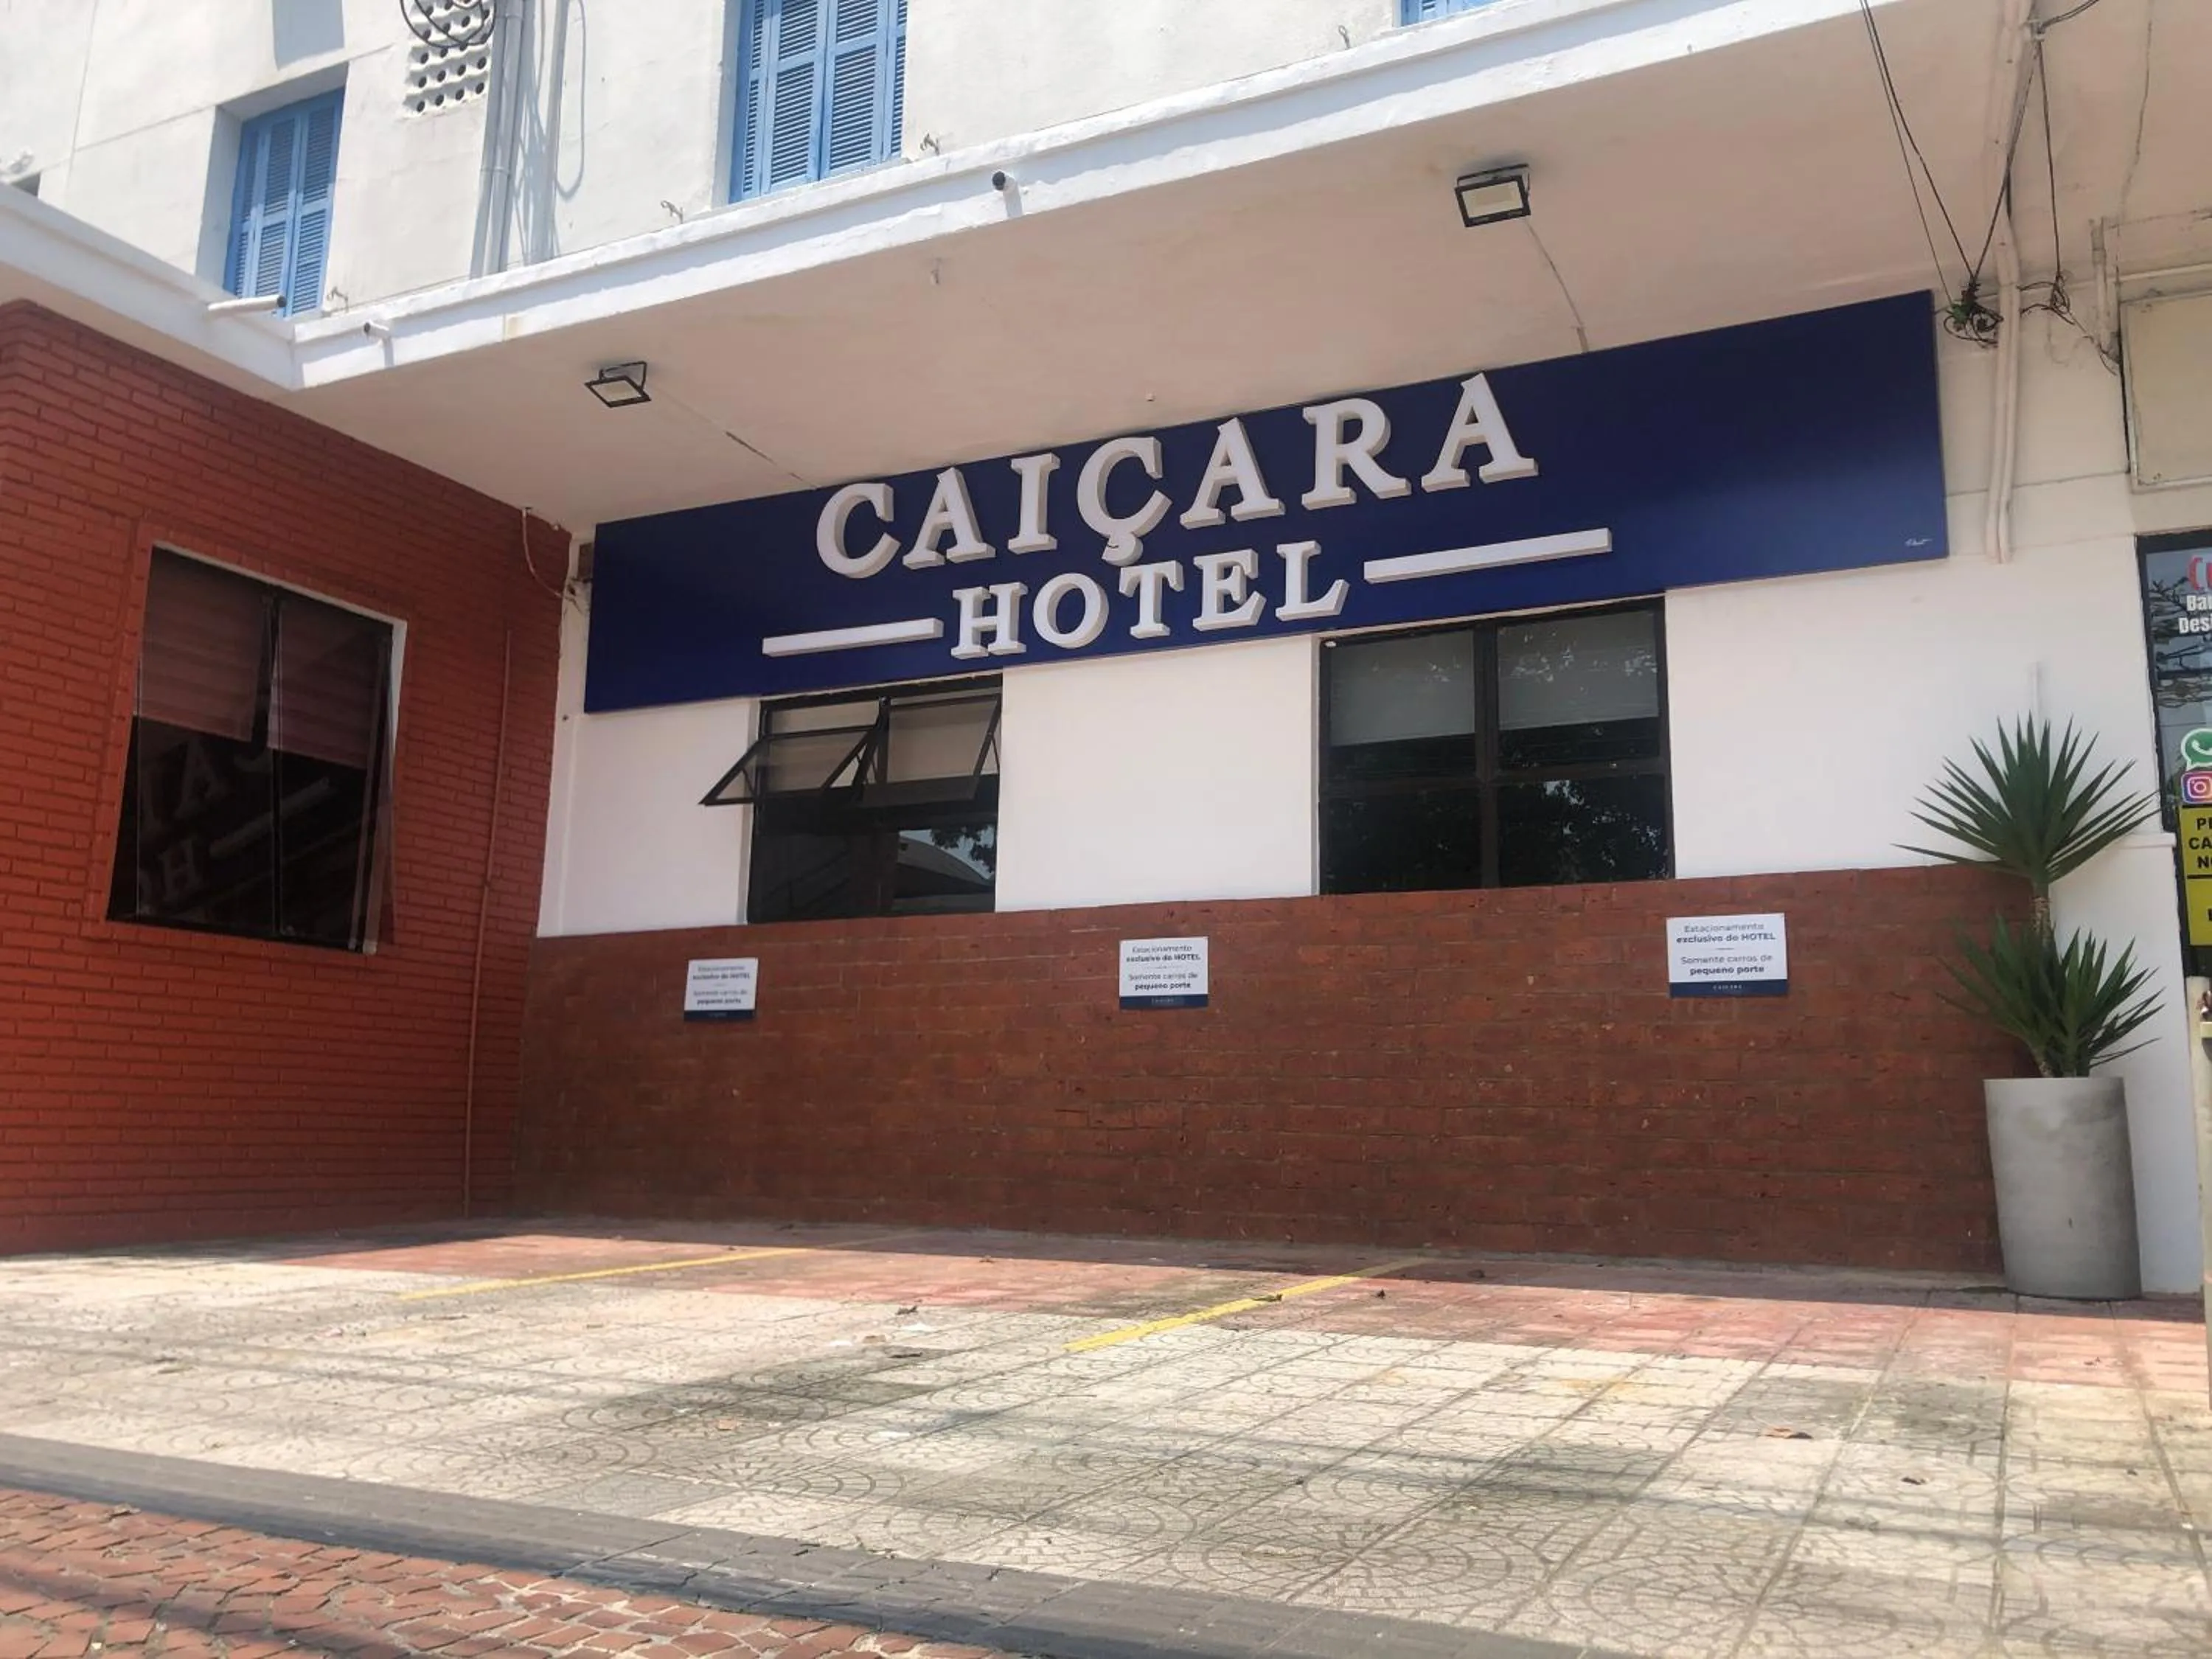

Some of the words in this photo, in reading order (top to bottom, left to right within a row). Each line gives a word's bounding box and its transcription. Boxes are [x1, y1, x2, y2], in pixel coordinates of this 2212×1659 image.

[815, 372, 1539, 578] CAIÇARA
[950, 540, 1349, 658] HOTEL
[2197, 855, 2212, 869] N
[1684, 922, 1764, 933] Estacionamento
[1676, 934, 1722, 943] exclusivo
[1726, 933, 1739, 942] do
[1741, 932, 1776, 941] HOTEL
[1680, 956, 1725, 964] Somente
[1727, 955, 1758, 963] carros
[1689, 967, 1734, 975] pequeno
[1736, 965, 1764, 974] porte
